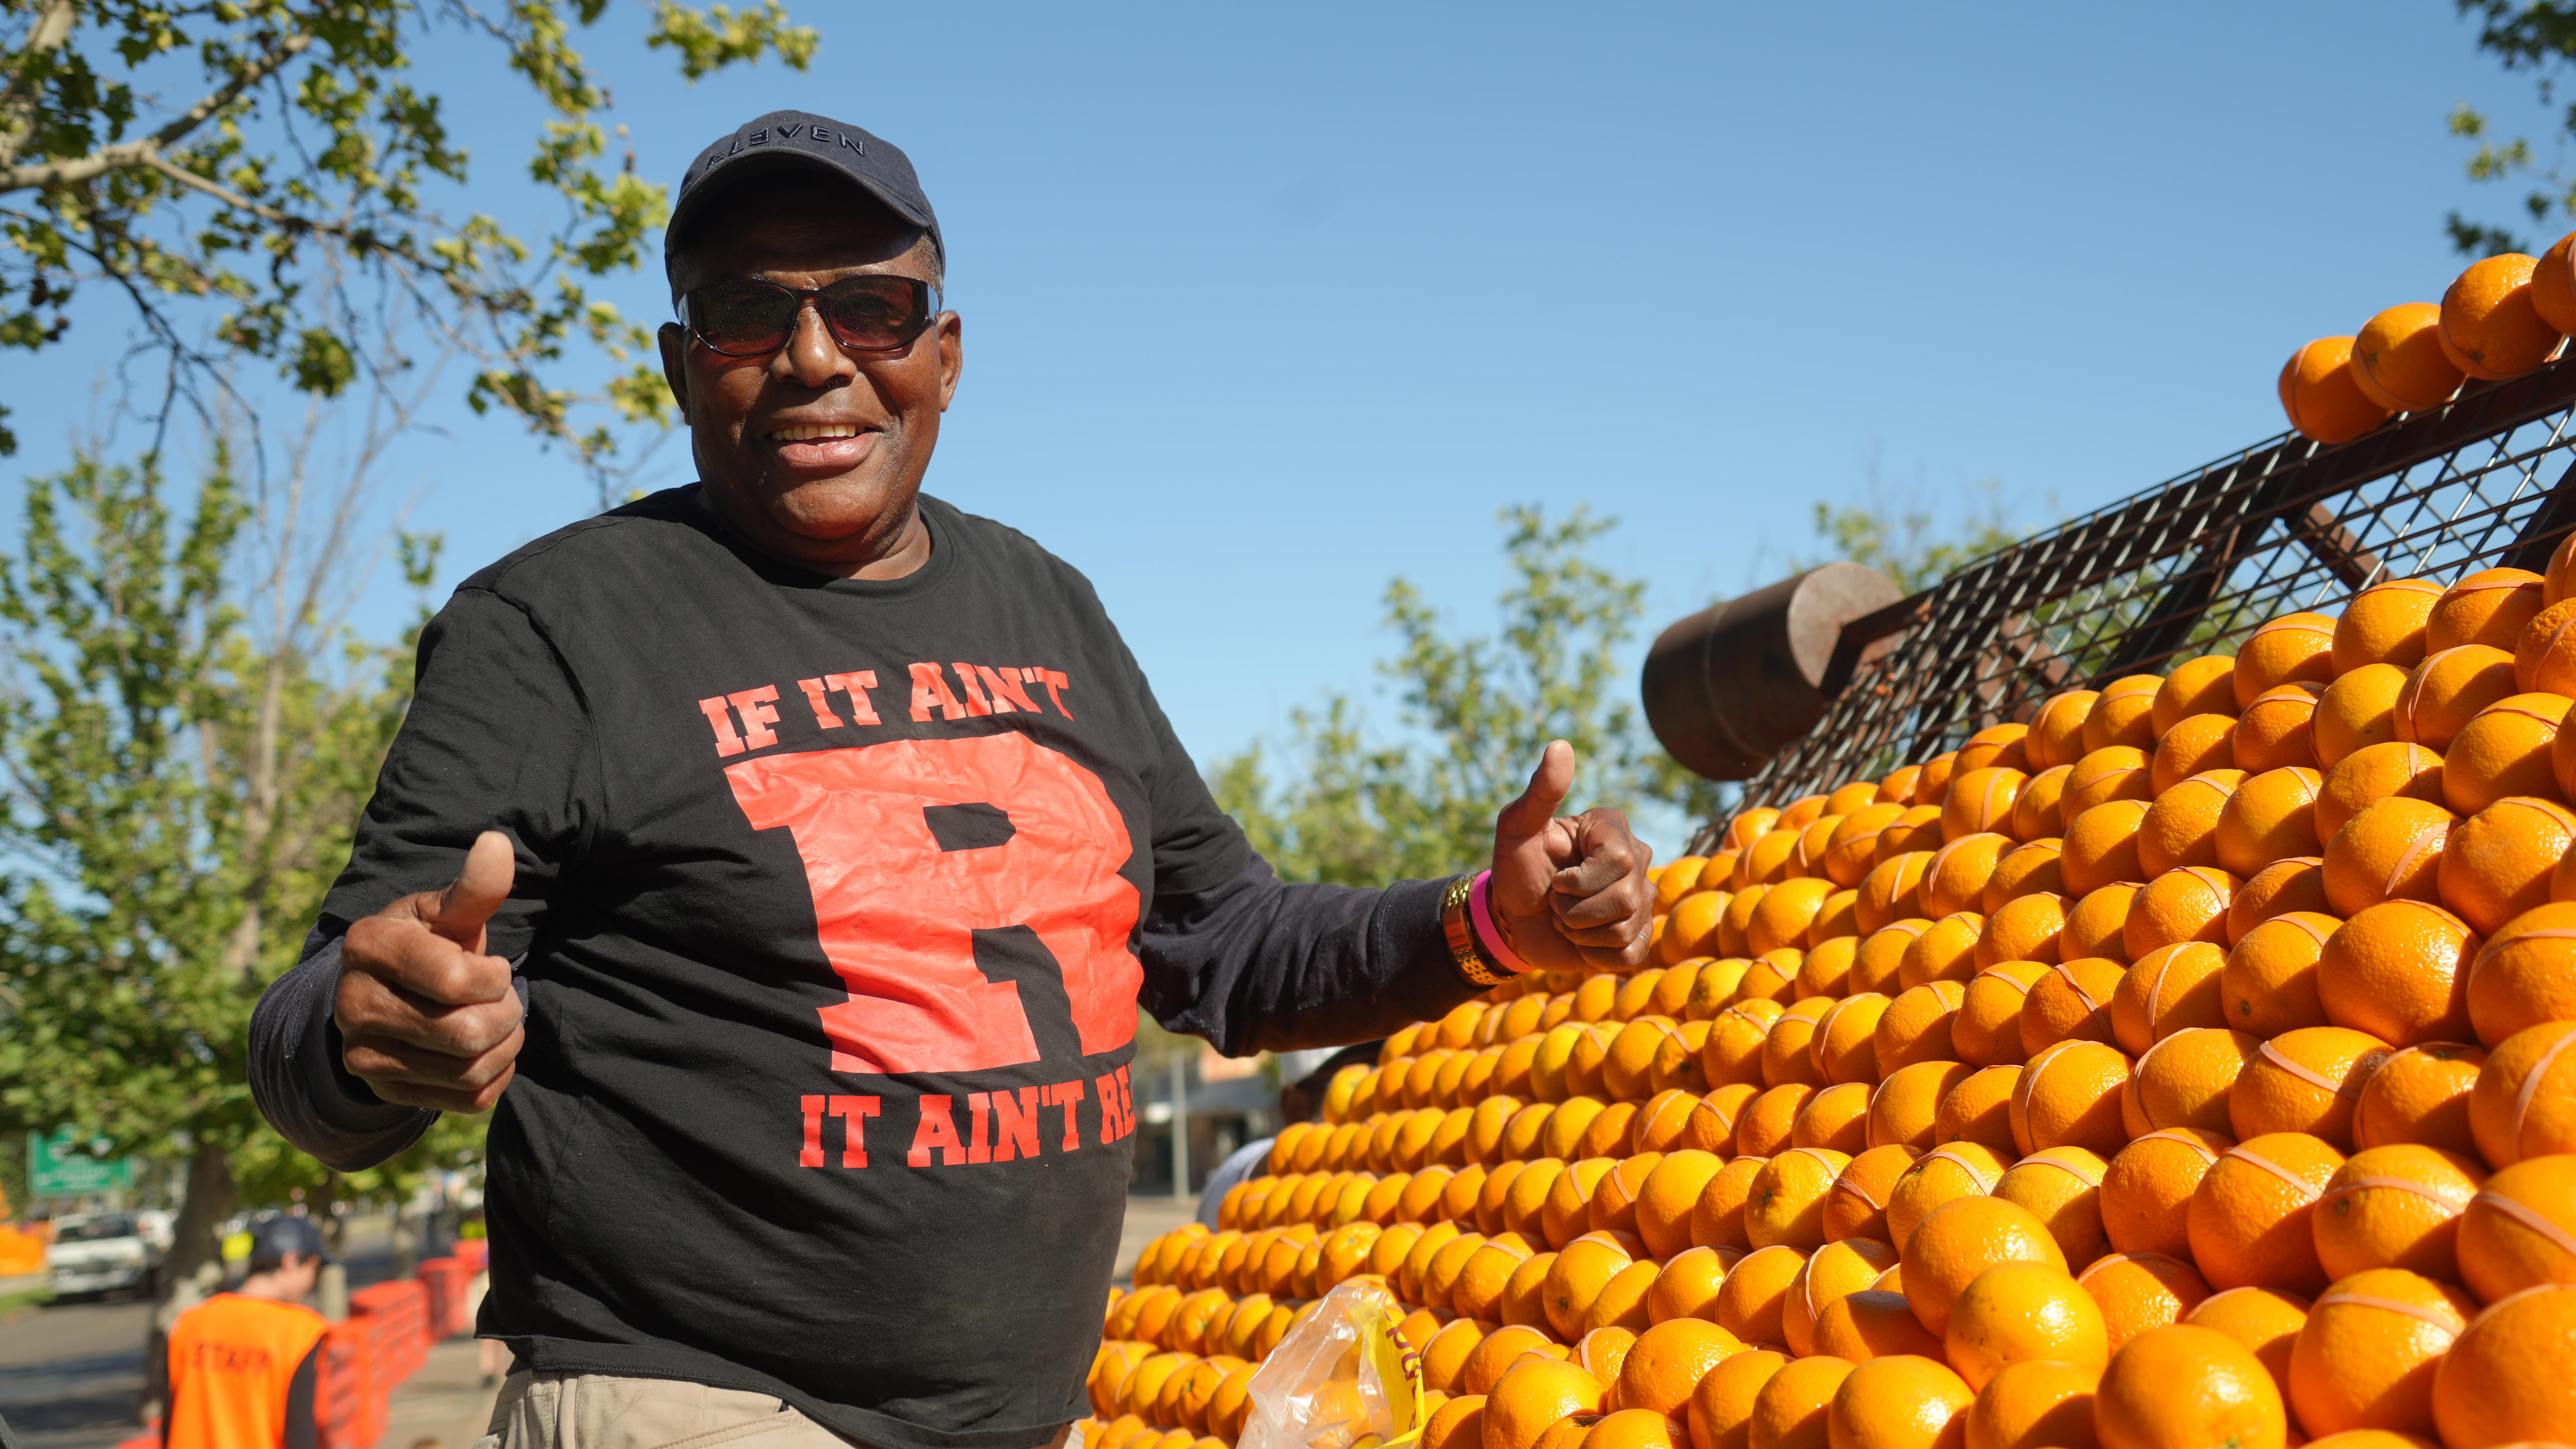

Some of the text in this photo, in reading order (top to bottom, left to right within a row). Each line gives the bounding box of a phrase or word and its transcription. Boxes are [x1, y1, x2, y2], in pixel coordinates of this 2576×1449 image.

[699, 661, 1075, 758] IF IT AIN'T
[723, 730, 1145, 1075] R
[799, 1095, 881, 1169] IT
[907, 1079, 1086, 1168] AIN'T
